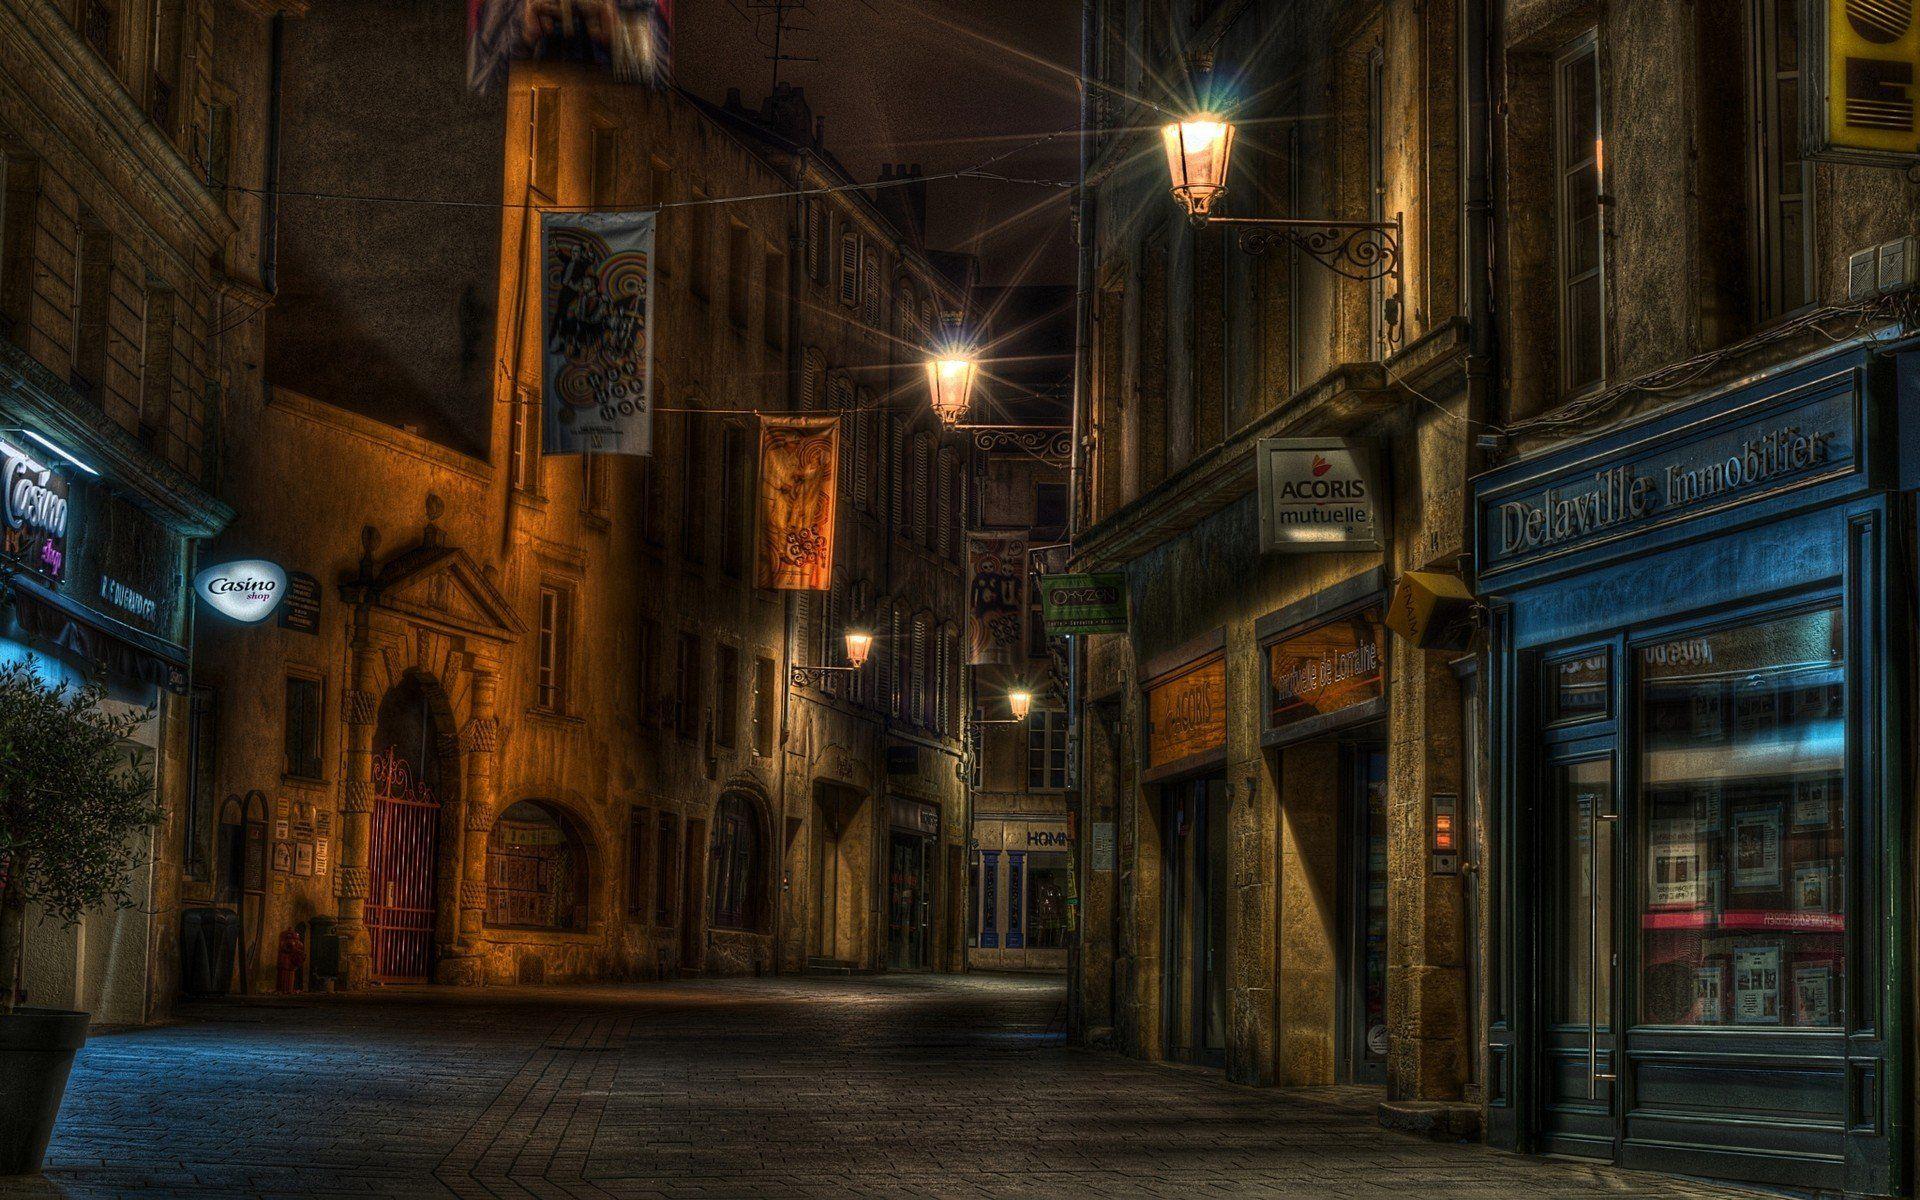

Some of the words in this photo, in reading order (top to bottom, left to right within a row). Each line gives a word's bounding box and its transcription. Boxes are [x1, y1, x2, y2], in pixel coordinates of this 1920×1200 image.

[2, 456, 68, 538] Casino
[1280, 480, 1365, 499] ACORIS
[1499, 465, 1649, 555] Delaville
[1663, 426, 1821, 507] Immobilier
[1280, 507, 1366, 524] mutuelle
[208, 577, 276, 595] Casino
[246, 592, 270, 602] shop
[1320, 651, 1332, 687] de
[1334, 639, 1377, 683] Lorraine
